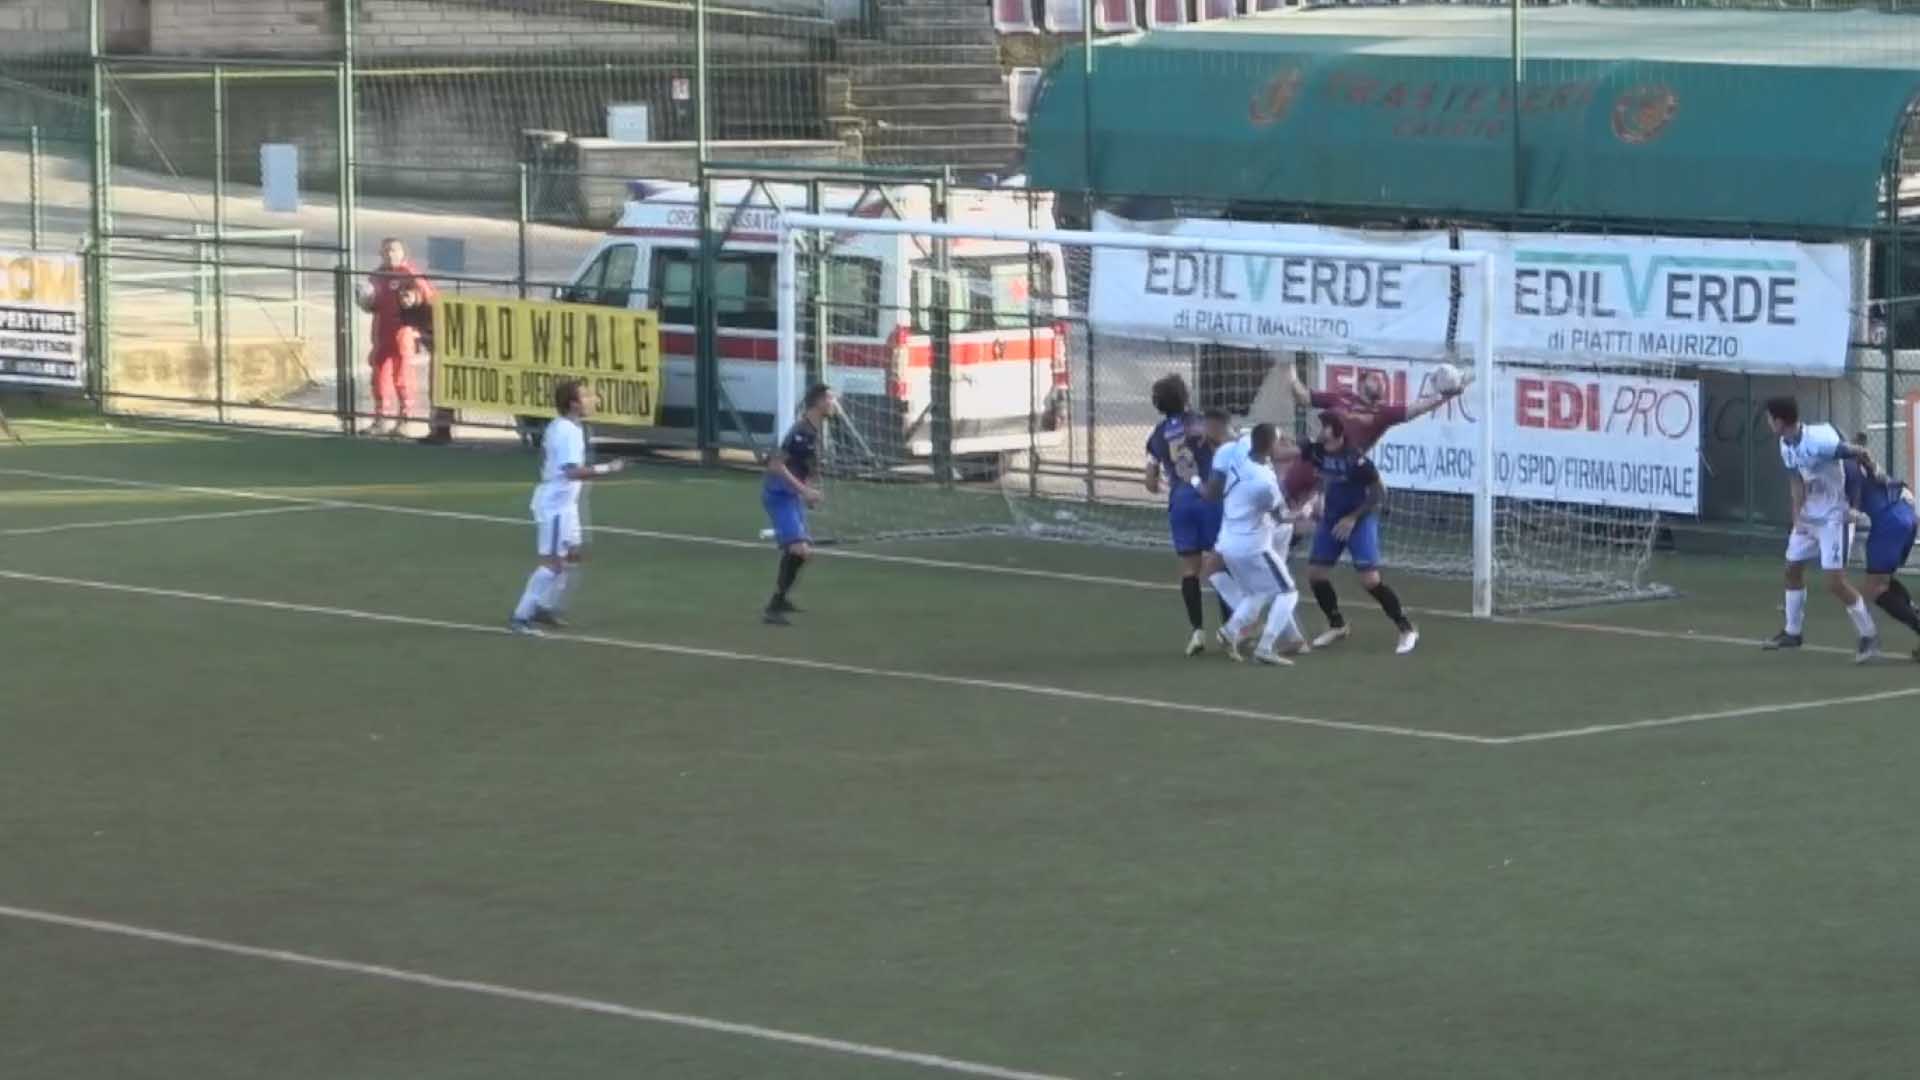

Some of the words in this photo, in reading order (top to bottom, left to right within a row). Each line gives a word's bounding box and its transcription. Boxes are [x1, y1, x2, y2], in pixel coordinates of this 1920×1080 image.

[1144, 250, 1402, 309] EDILVERDE
[1514, 257, 1796, 326] EDILVERDE
[443, 302, 513, 361] MAD
[531, 308, 648, 373] WHALE
[1174, 312, 1191, 330] di
[1196, 312, 1250, 335] PIATTI
[1257, 315, 1349, 339] MAURIZIO
[1548, 331, 1566, 350] di
[1571, 329, 1633, 353] PIATTI
[1639, 331, 1738, 358] MAURIZIO
[443, 363, 498, 403] TATTOO
[595, 377, 650, 416] STUDIO
[1515, 376, 1601, 432] EDI
[1606, 384, 1694, 439] PRO
[1620, 462, 1694, 499] DIGITALE
